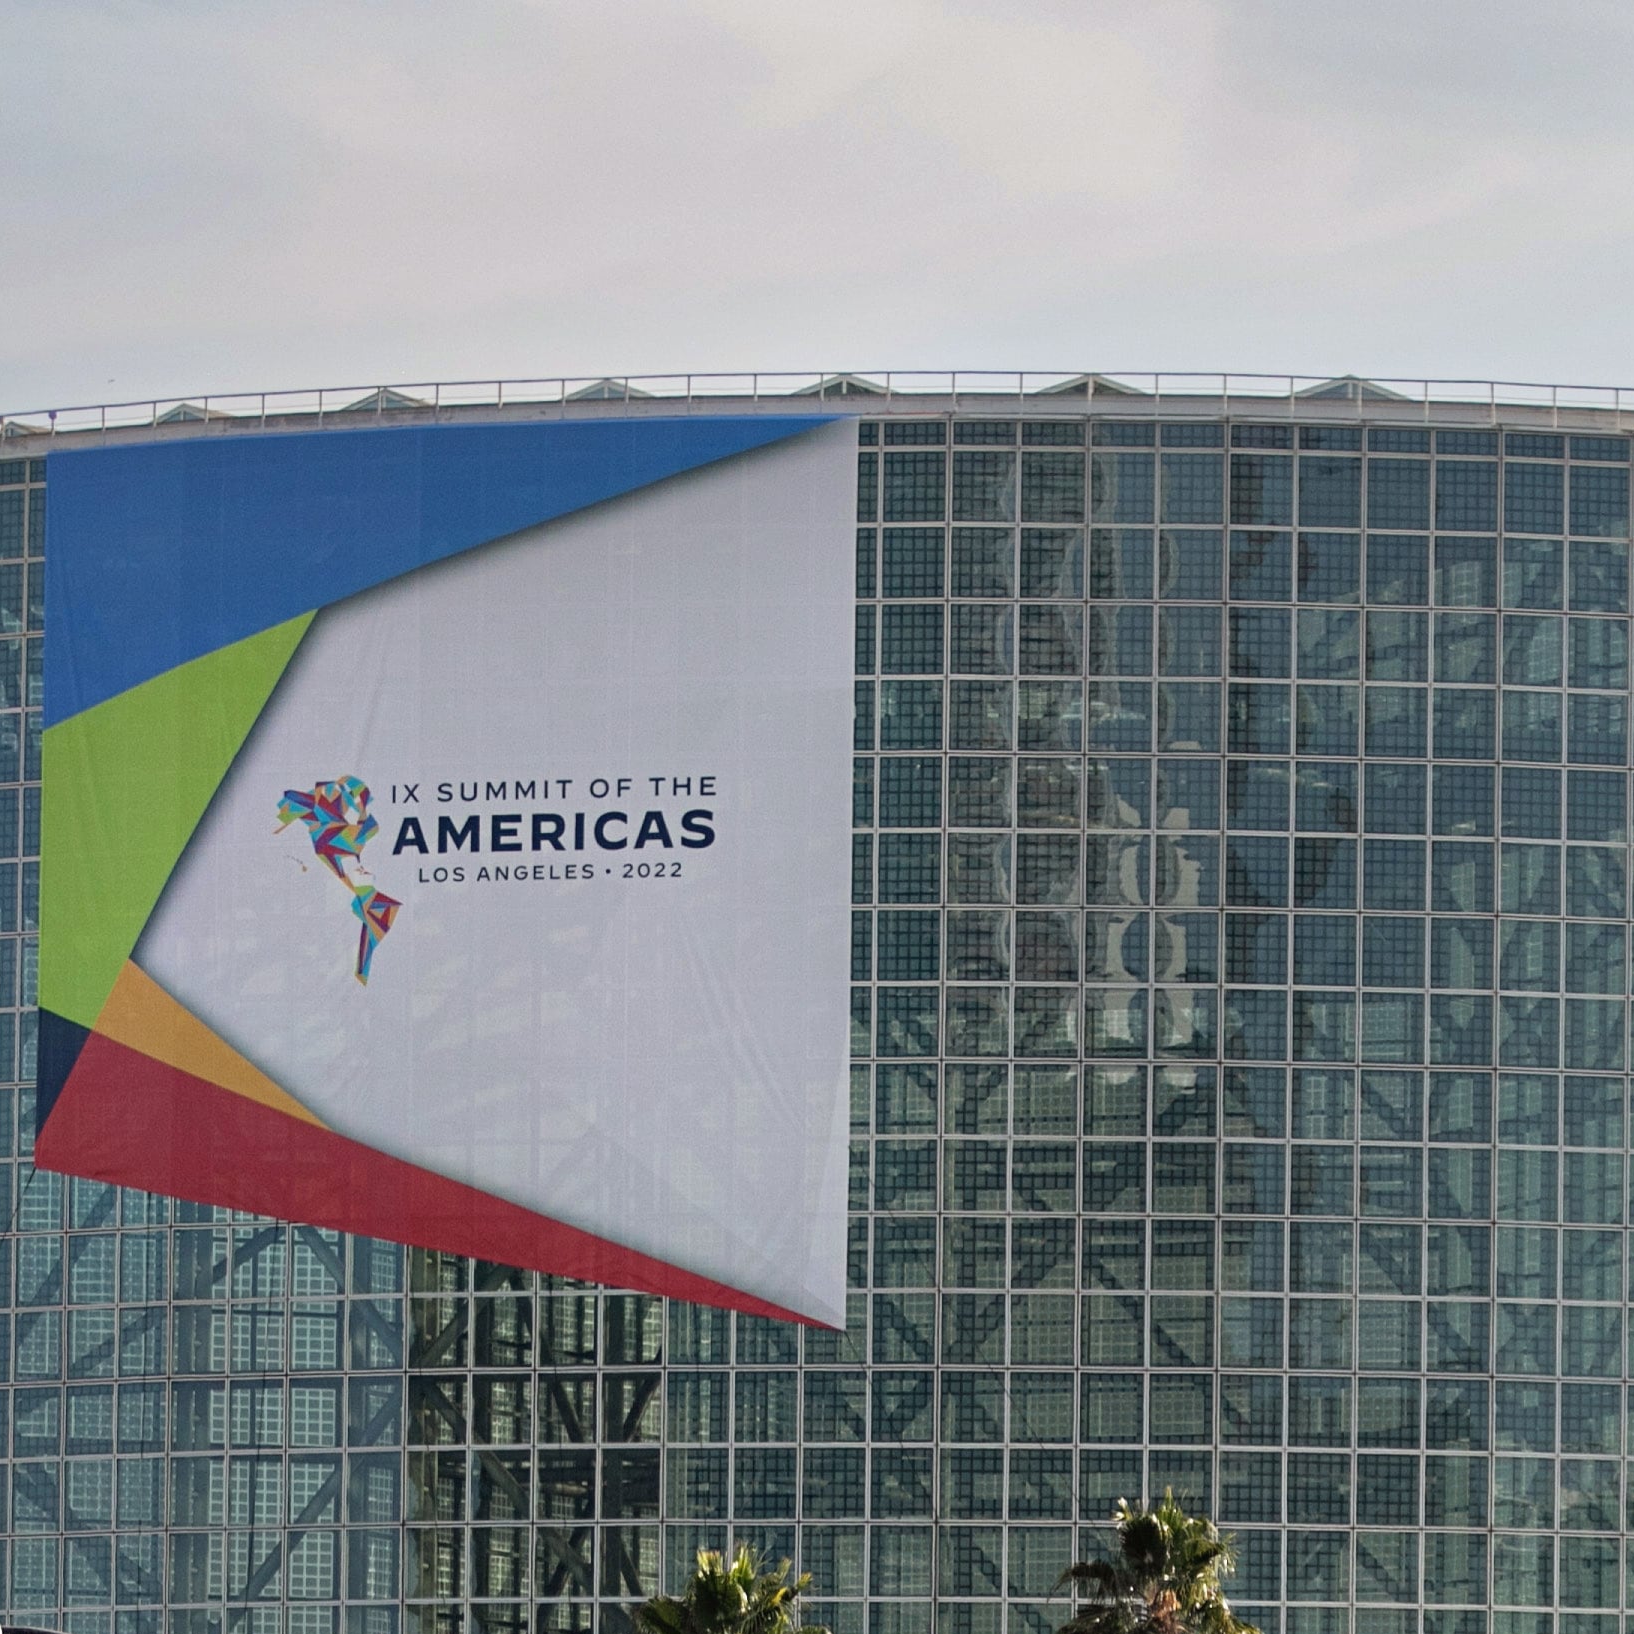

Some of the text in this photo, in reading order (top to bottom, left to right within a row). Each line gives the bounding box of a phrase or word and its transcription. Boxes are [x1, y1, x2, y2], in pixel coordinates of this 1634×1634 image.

[391, 776, 717, 803] IX SUMMIT OF THE
[392, 809, 715, 855] AMERICAS
[419, 862, 683, 883] LOS ANGELES 2022
